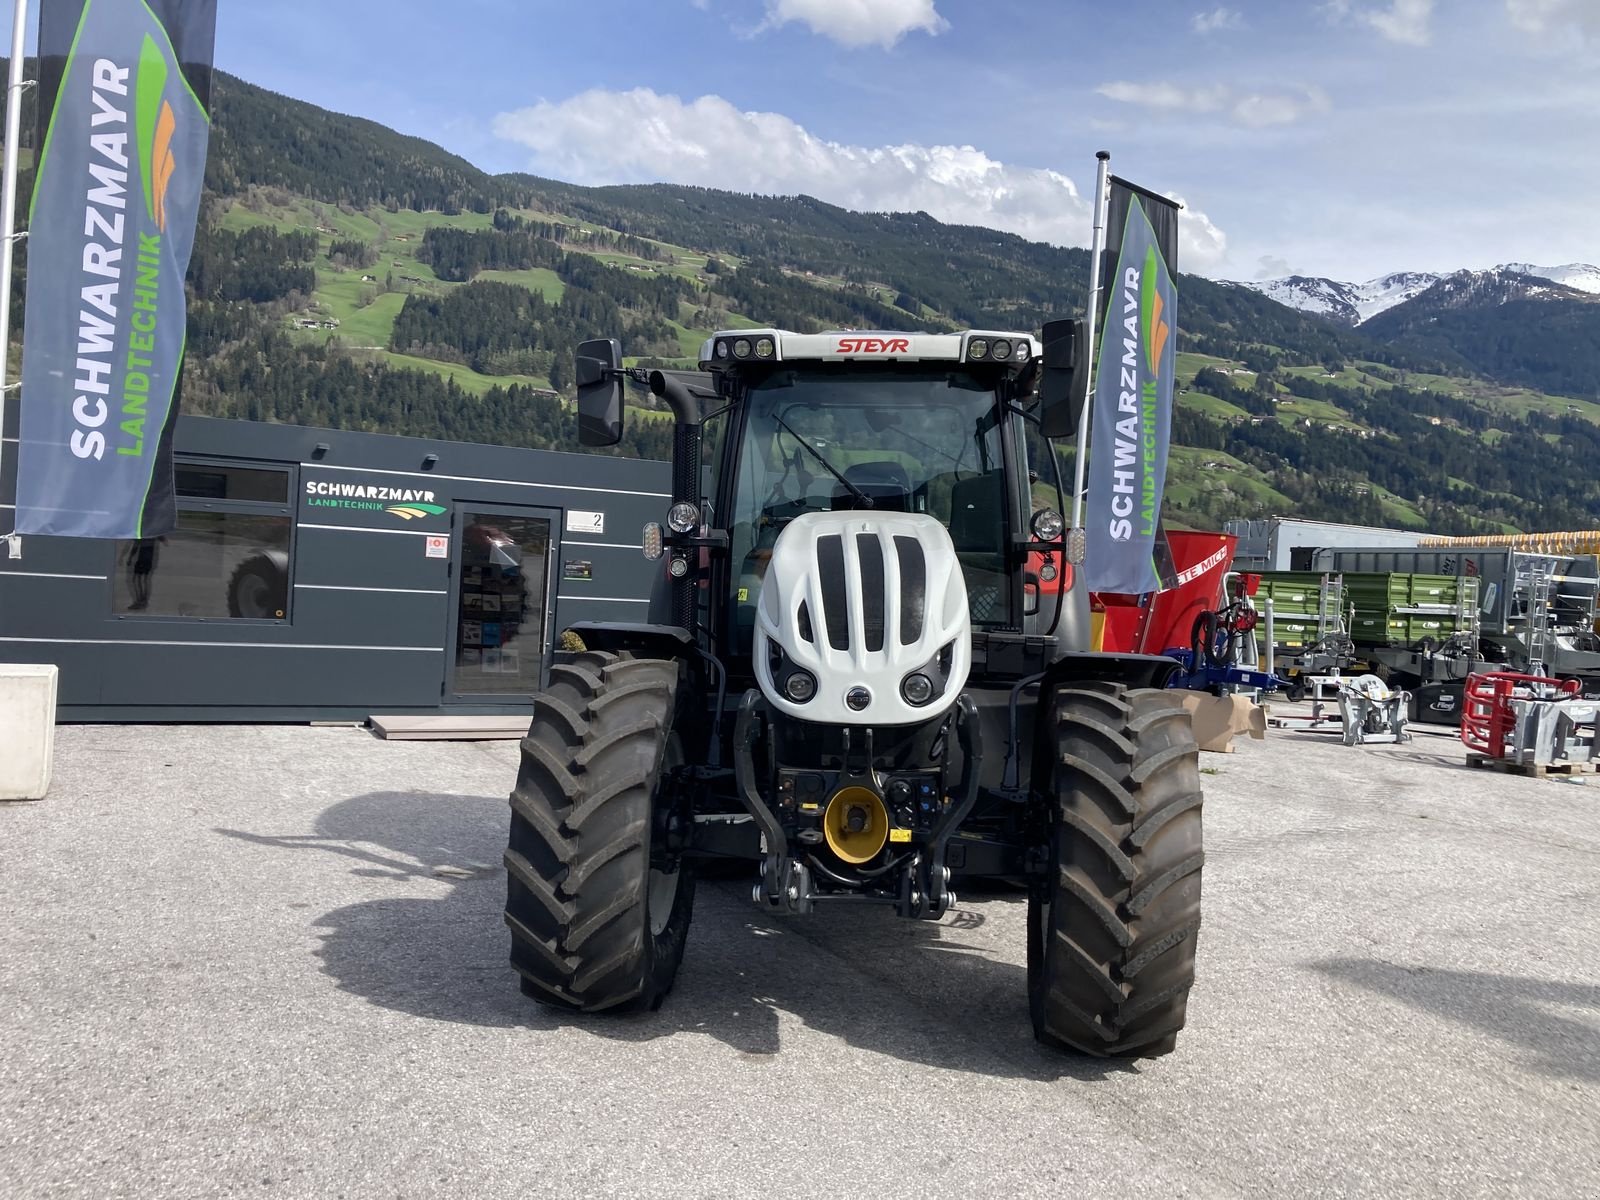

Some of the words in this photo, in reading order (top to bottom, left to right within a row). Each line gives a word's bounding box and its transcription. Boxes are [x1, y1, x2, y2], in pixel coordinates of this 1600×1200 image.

[70, 57, 130, 462] SCHWARZMAYR
[116, 229, 162, 458] LANDTECHNIK
[836, 338, 909, 353] STEYR
[1109, 266, 1140, 542] SCHWARZMAYR
[305, 481, 435, 503] SCHWARZMAYR
[1140, 379, 1157, 537] LANDTECHNIK
[308, 498, 383, 511] LANDTECHNIK
[593, 513, 602, 527] 2
